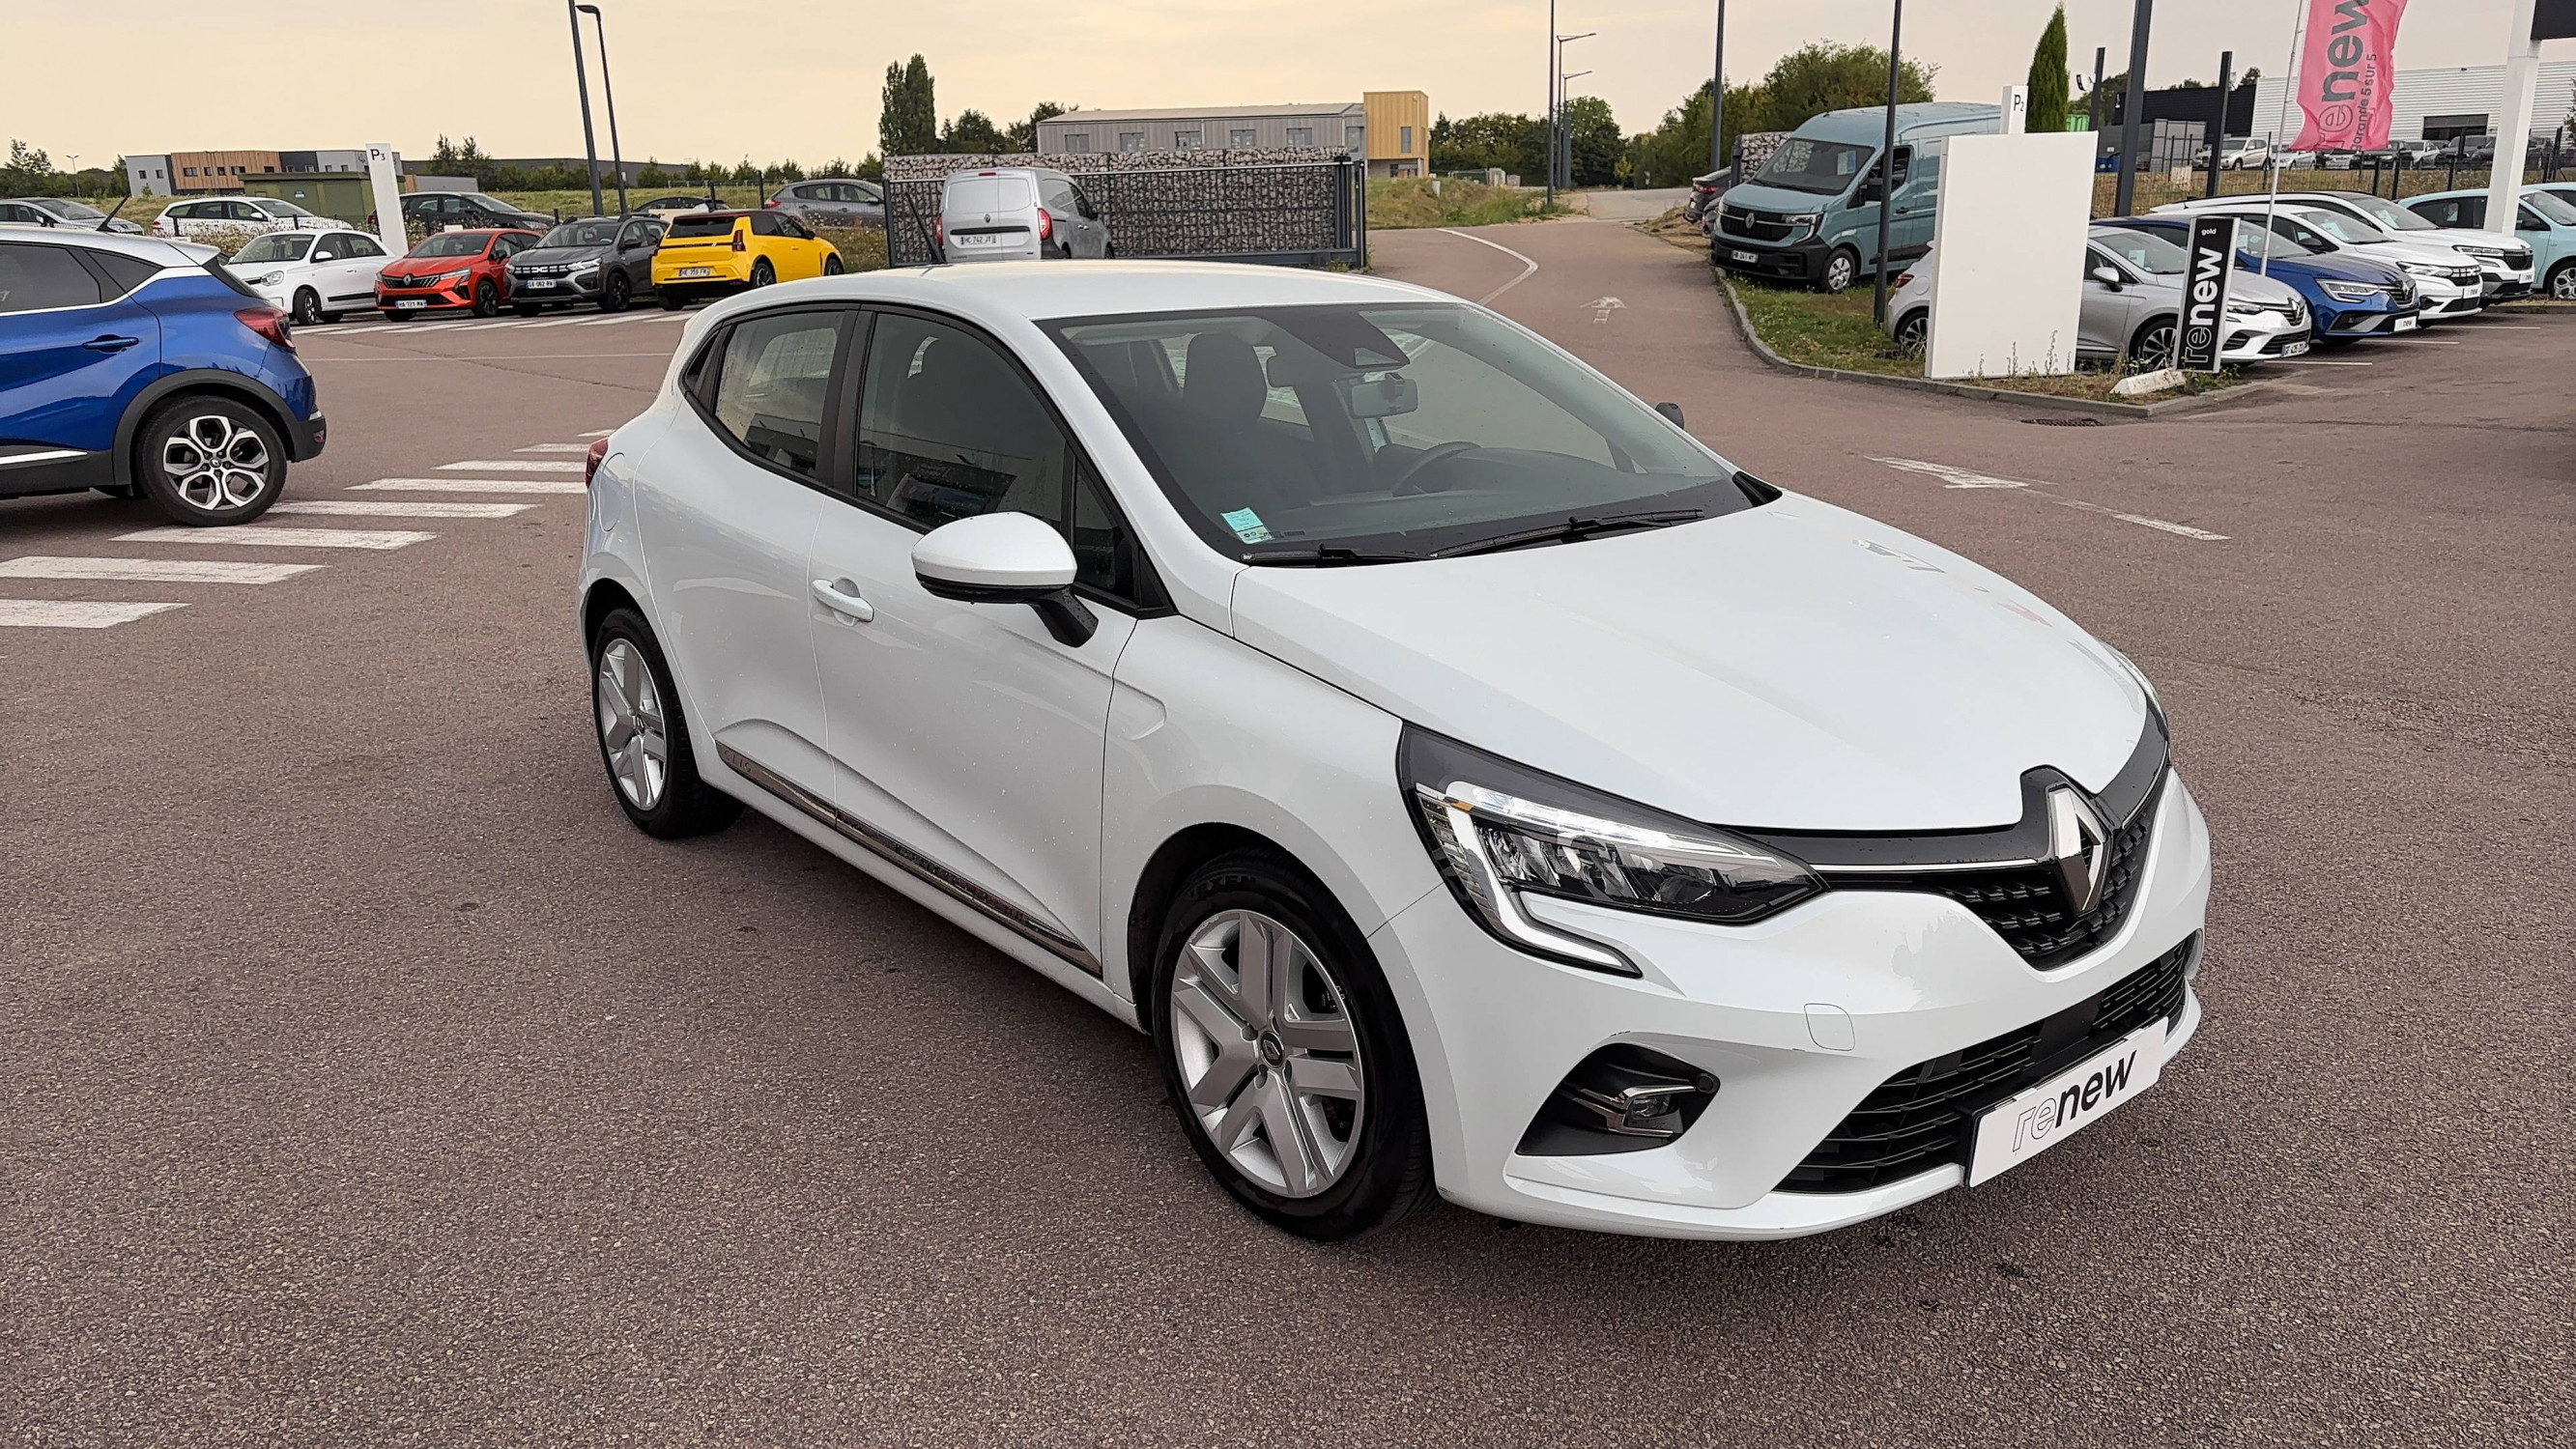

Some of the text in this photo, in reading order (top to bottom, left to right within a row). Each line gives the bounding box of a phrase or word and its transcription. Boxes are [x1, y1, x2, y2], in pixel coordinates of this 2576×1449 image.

[2365, 53, 2377, 62] 5
[2364, 64, 2377, 87] sur
[2361, 87, 2372, 96] 5
[2200, 228, 2218, 237] gold
[2184, 246, 2223, 363] renew
[724, 750, 753, 773] CLIO
[2012, 1049, 2137, 1152] renew
